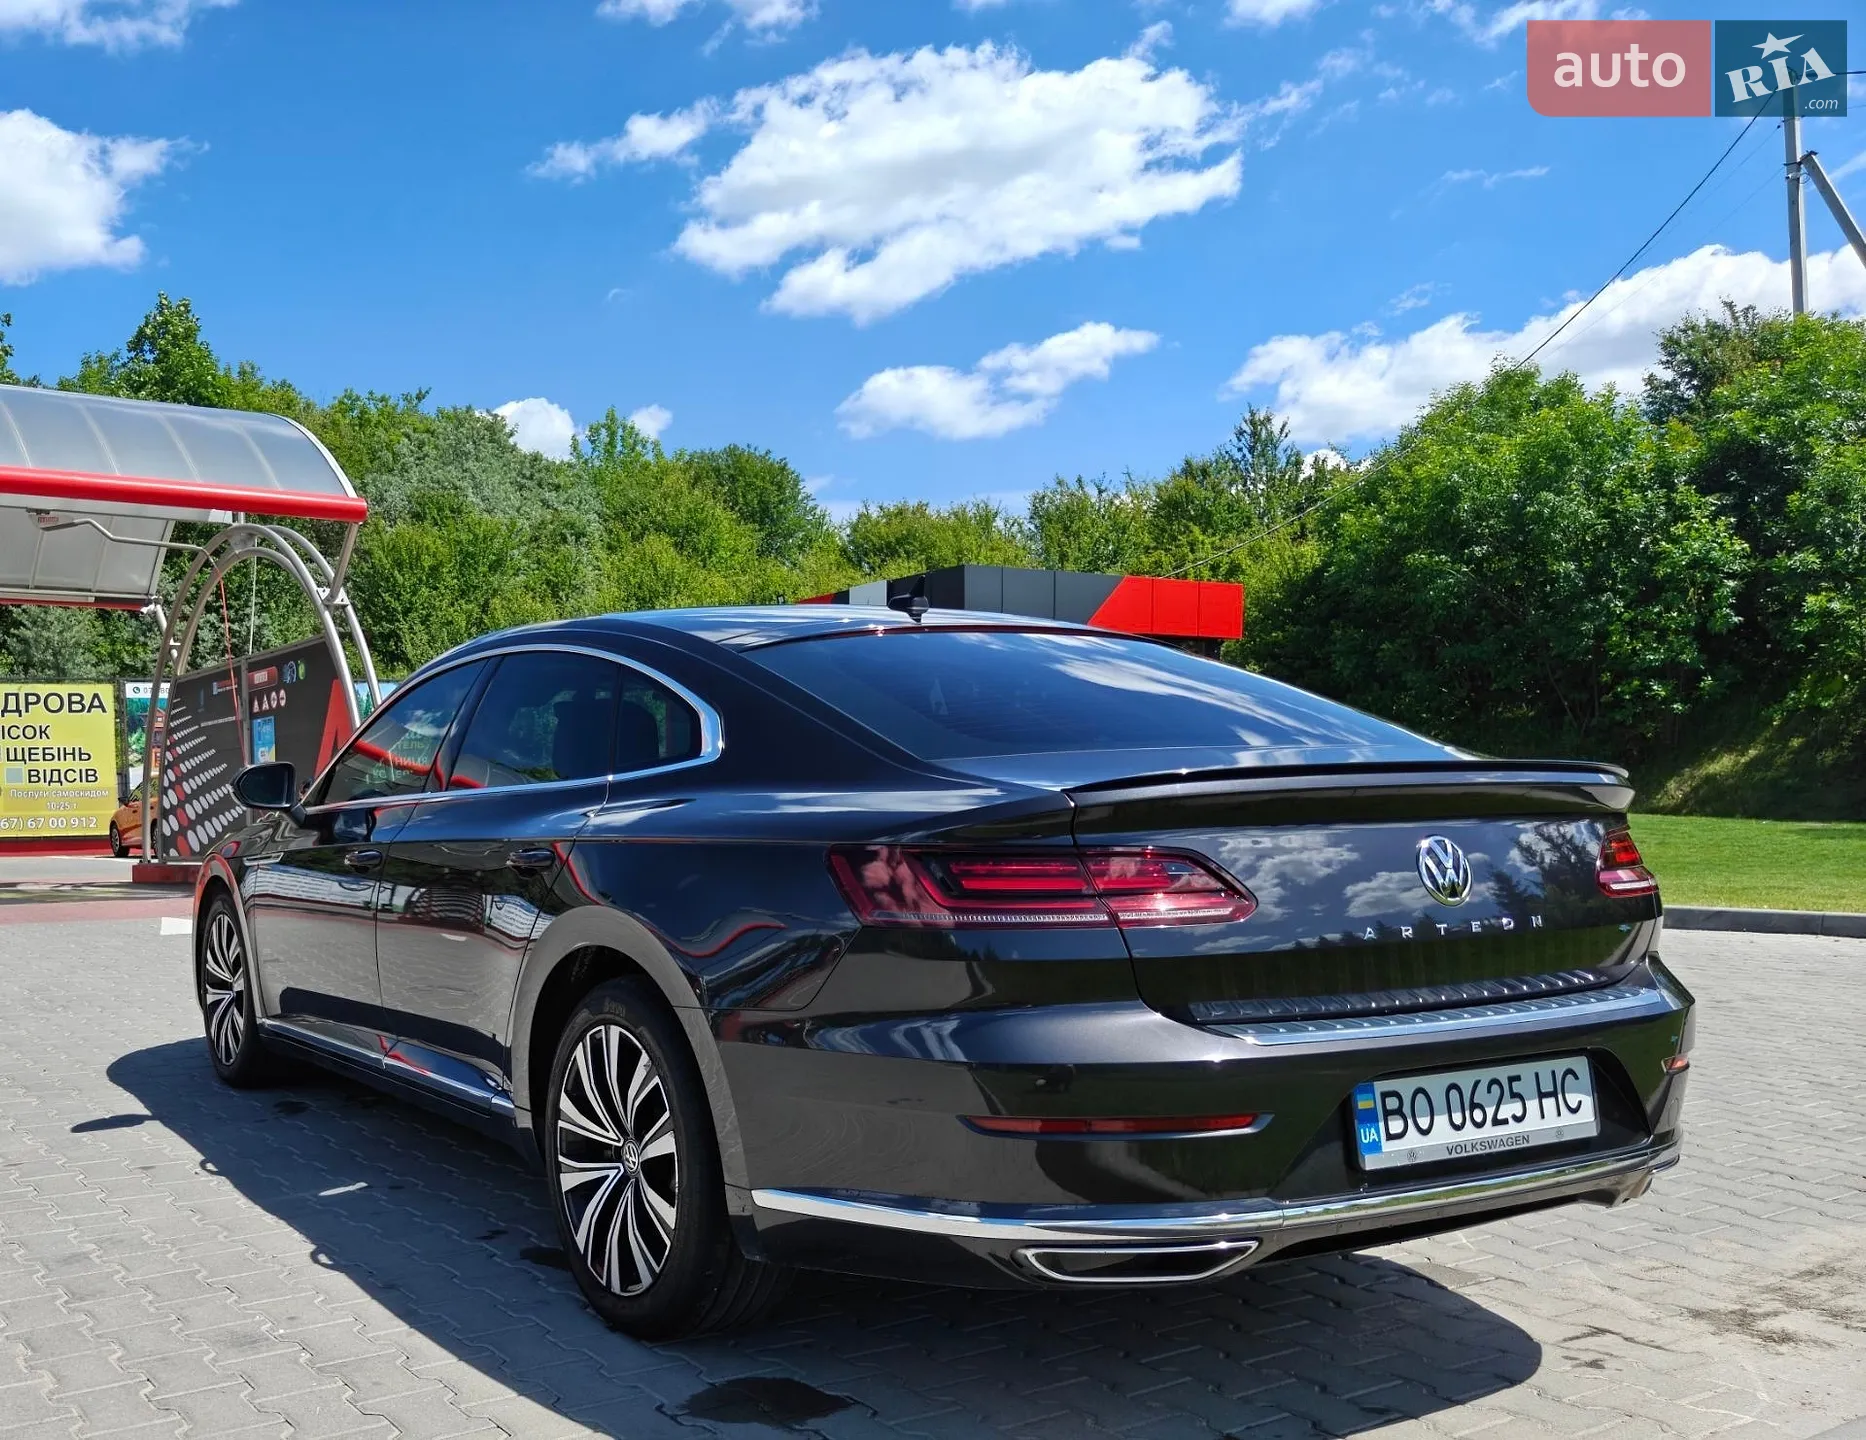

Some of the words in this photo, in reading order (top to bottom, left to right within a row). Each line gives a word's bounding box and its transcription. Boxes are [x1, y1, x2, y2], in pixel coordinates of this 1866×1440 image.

[1, 692, 107, 717] ДРОВА
[6, 746, 92, 765] ЩЕБІНЬ
[27, 768, 98, 786] ВІДСІВ
[10, 789, 50, 800] Послуги
[51, 788, 109, 799] самоскидом
[27, 817, 45, 829] 67
[49, 817, 67, 829] 00
[70, 816, 98, 828] 912
[1380, 1086, 1435, 1142] BO
[1445, 1074, 1528, 1132] 0625
[1534, 1067, 1583, 1120] HC
[1360, 1128, 1379, 1144] UA
[1446, 1134, 1531, 1156] VOLKSWAGEN
